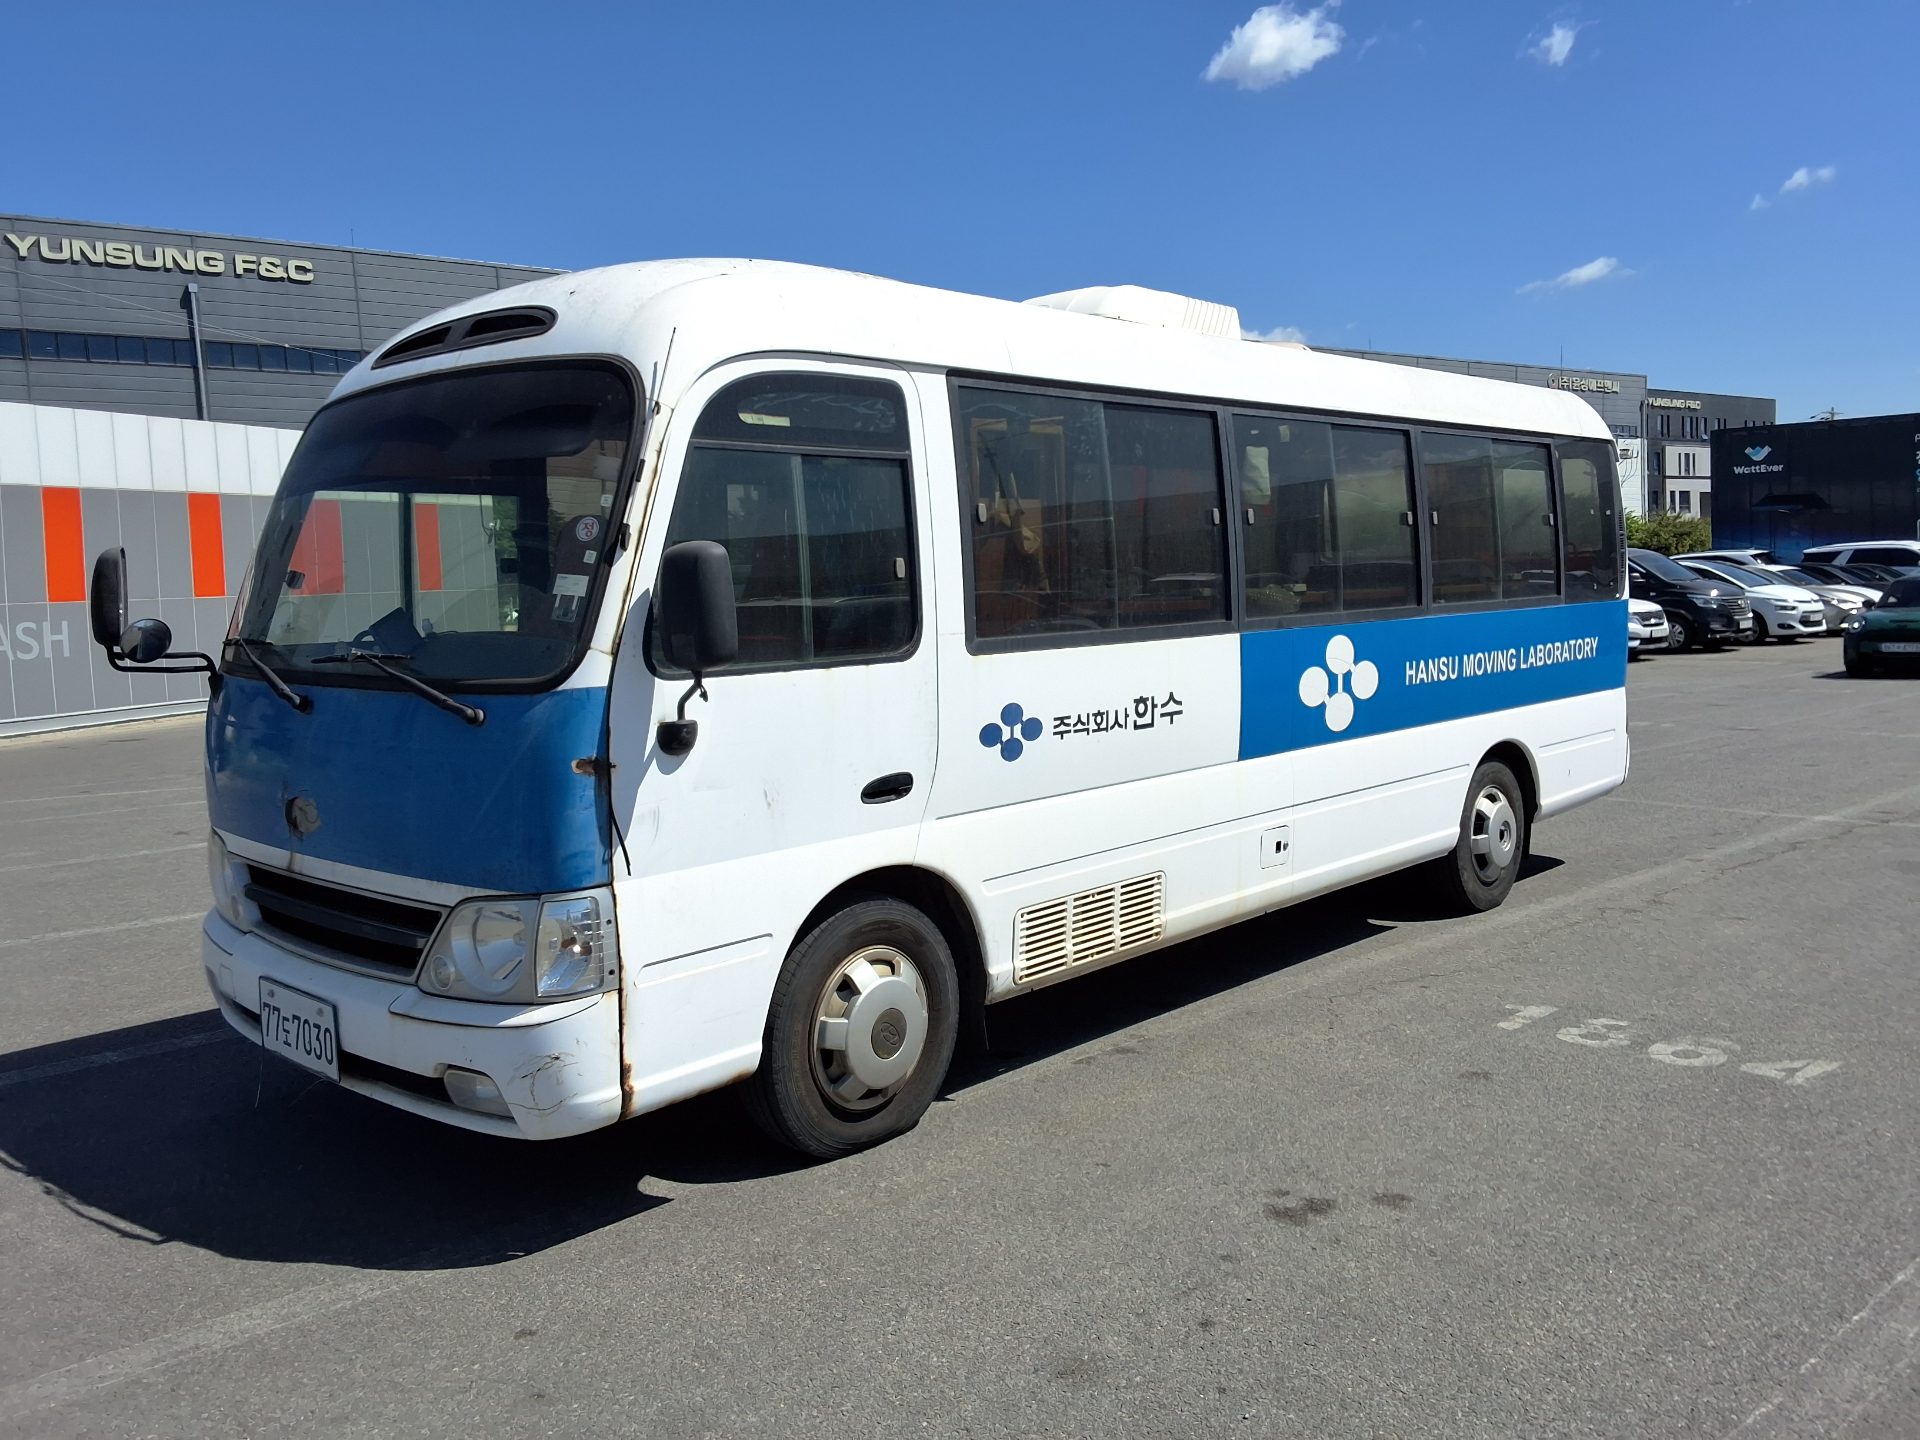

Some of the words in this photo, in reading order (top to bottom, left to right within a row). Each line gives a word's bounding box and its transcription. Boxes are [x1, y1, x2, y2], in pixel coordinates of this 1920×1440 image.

[4, 233, 225, 274] YUNSUNG
[234, 253, 314, 282] F&C
[1648, 397, 1686, 408] YUNSUNG
[1733, 464, 1784, 475] WattEver
[1405, 655, 1459, 686] HANSU
[1462, 648, 1517, 678] MOVING
[1520, 636, 1599, 669] LABORATORY
[262, 1001, 334, 1066] 77도7030
